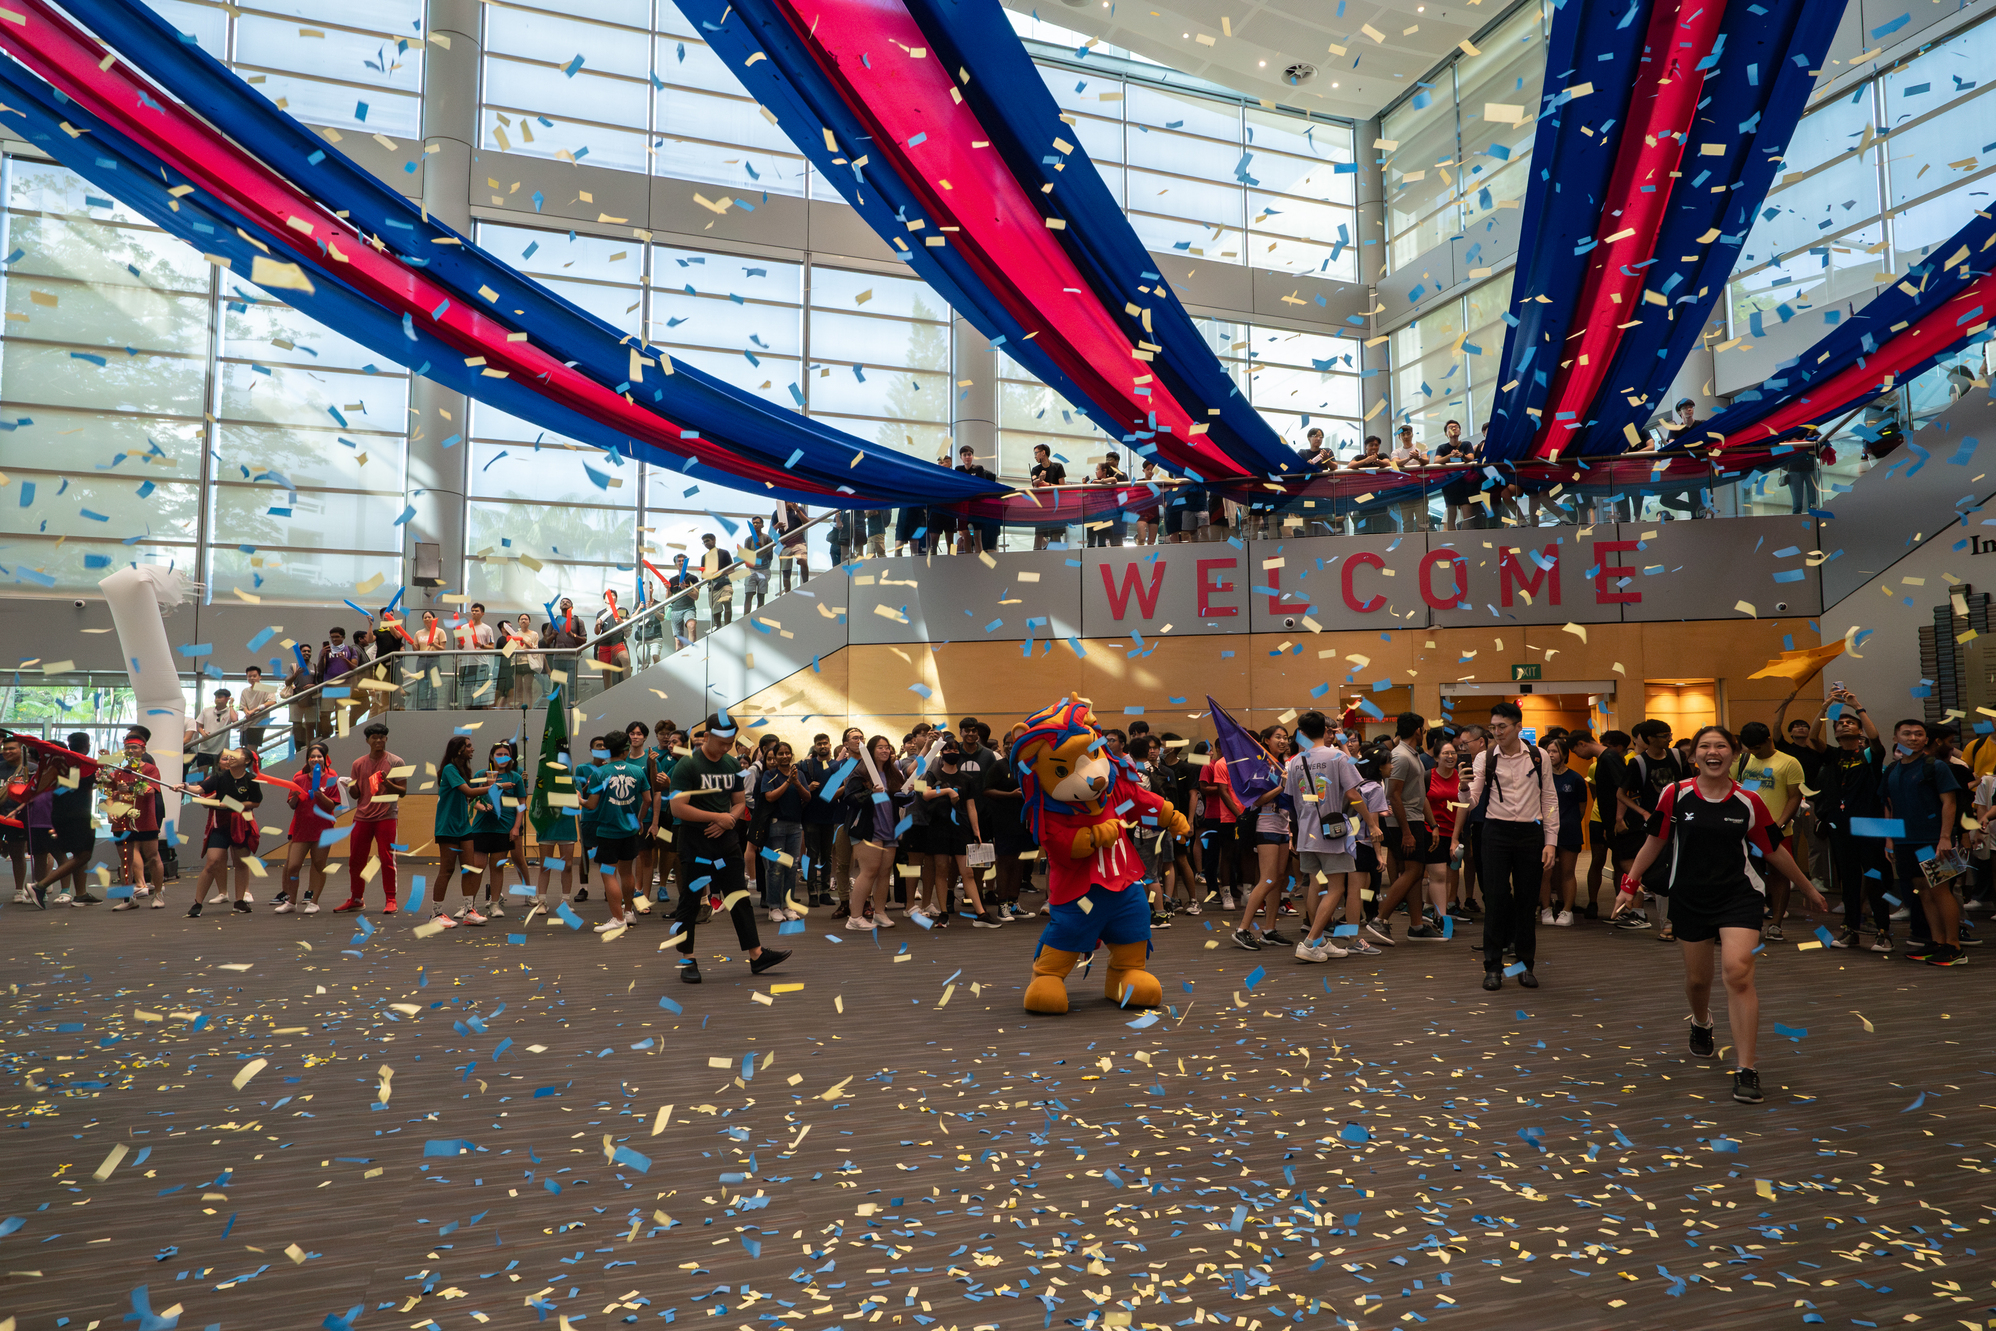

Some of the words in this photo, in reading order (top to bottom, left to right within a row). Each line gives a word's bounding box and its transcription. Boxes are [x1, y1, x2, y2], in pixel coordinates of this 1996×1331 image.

[1098, 540, 1643, 621] WELCOME
[1516, 666, 1537, 677] XIT
[700, 773, 734, 790] NTU
